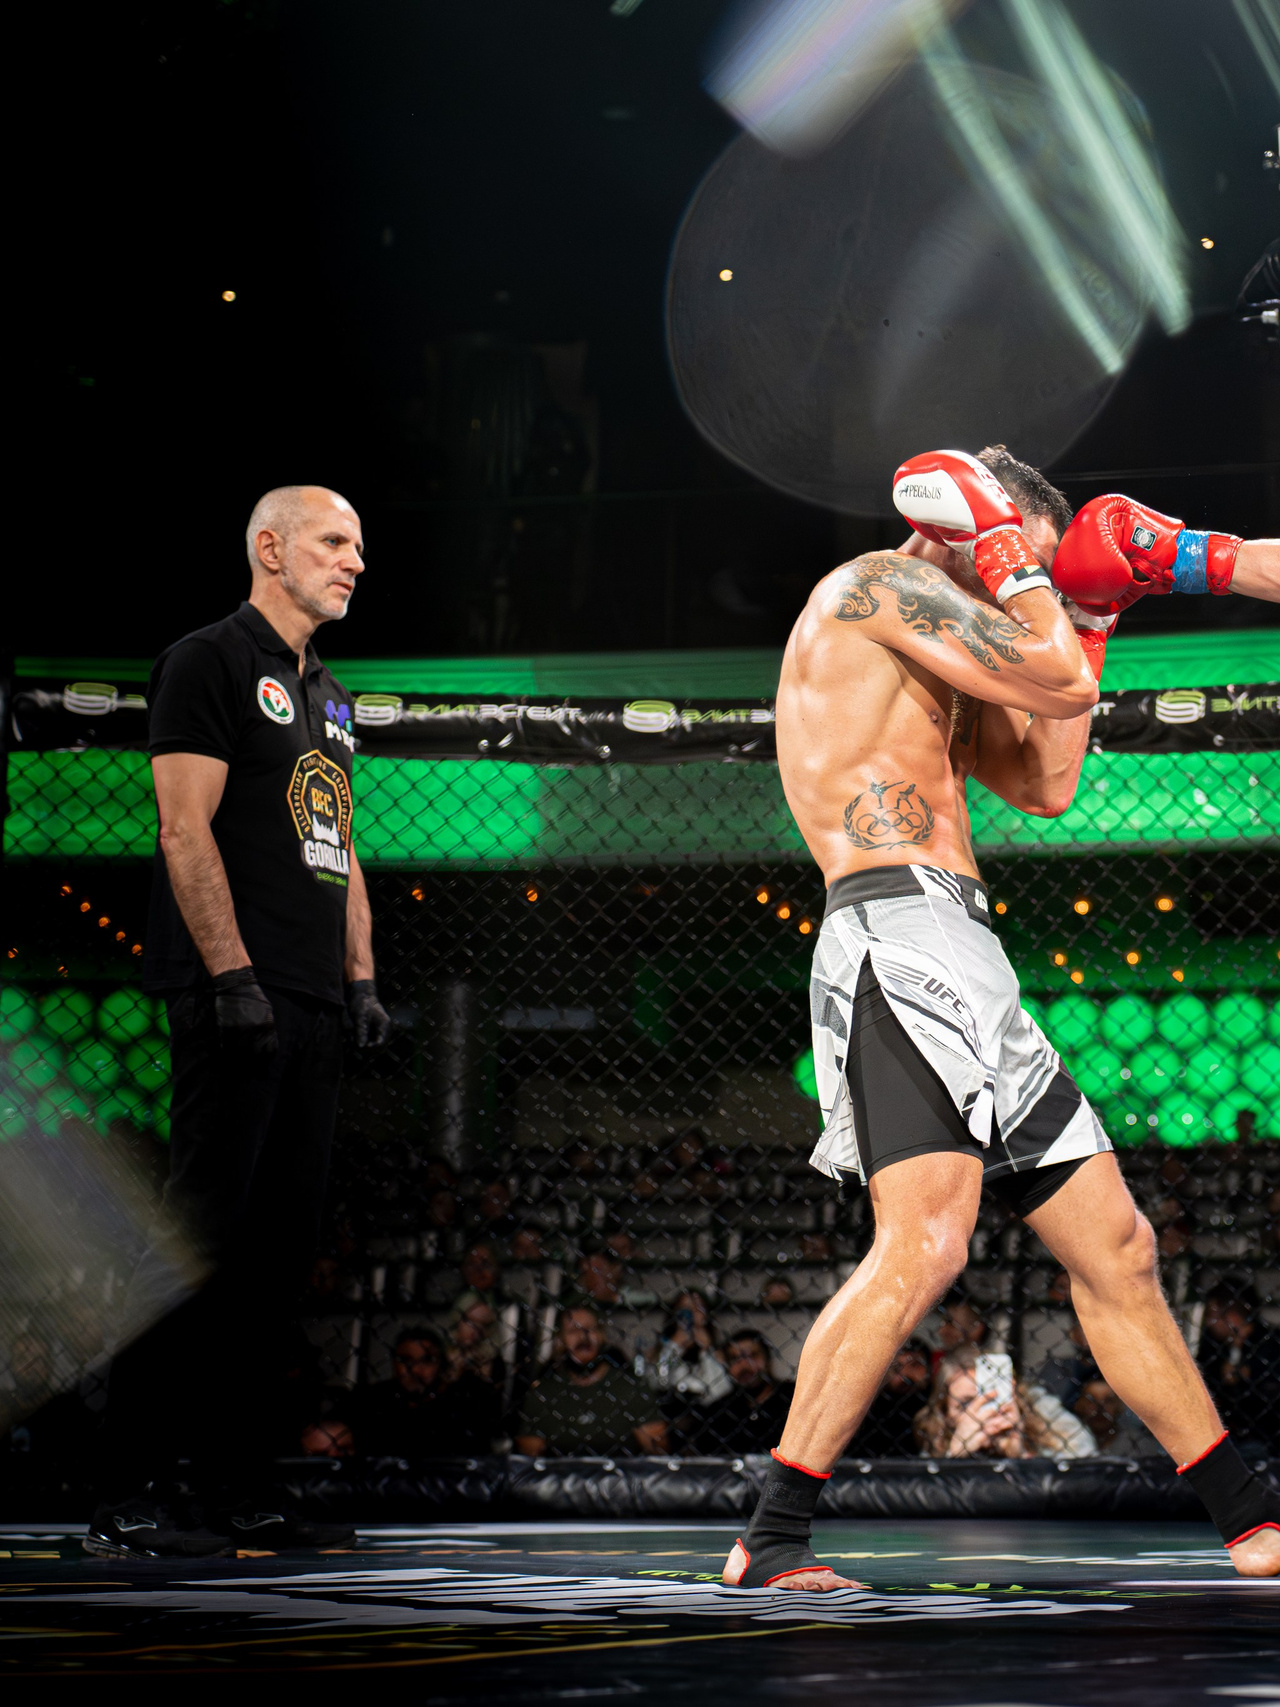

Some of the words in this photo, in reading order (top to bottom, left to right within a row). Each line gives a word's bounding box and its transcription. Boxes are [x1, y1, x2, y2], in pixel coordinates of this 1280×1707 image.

[908, 484, 942, 500] PEGASUS
[310, 787, 334, 817] BFC
[304, 840, 349, 875] GORILLA
[923, 977, 966, 1014] UFC
